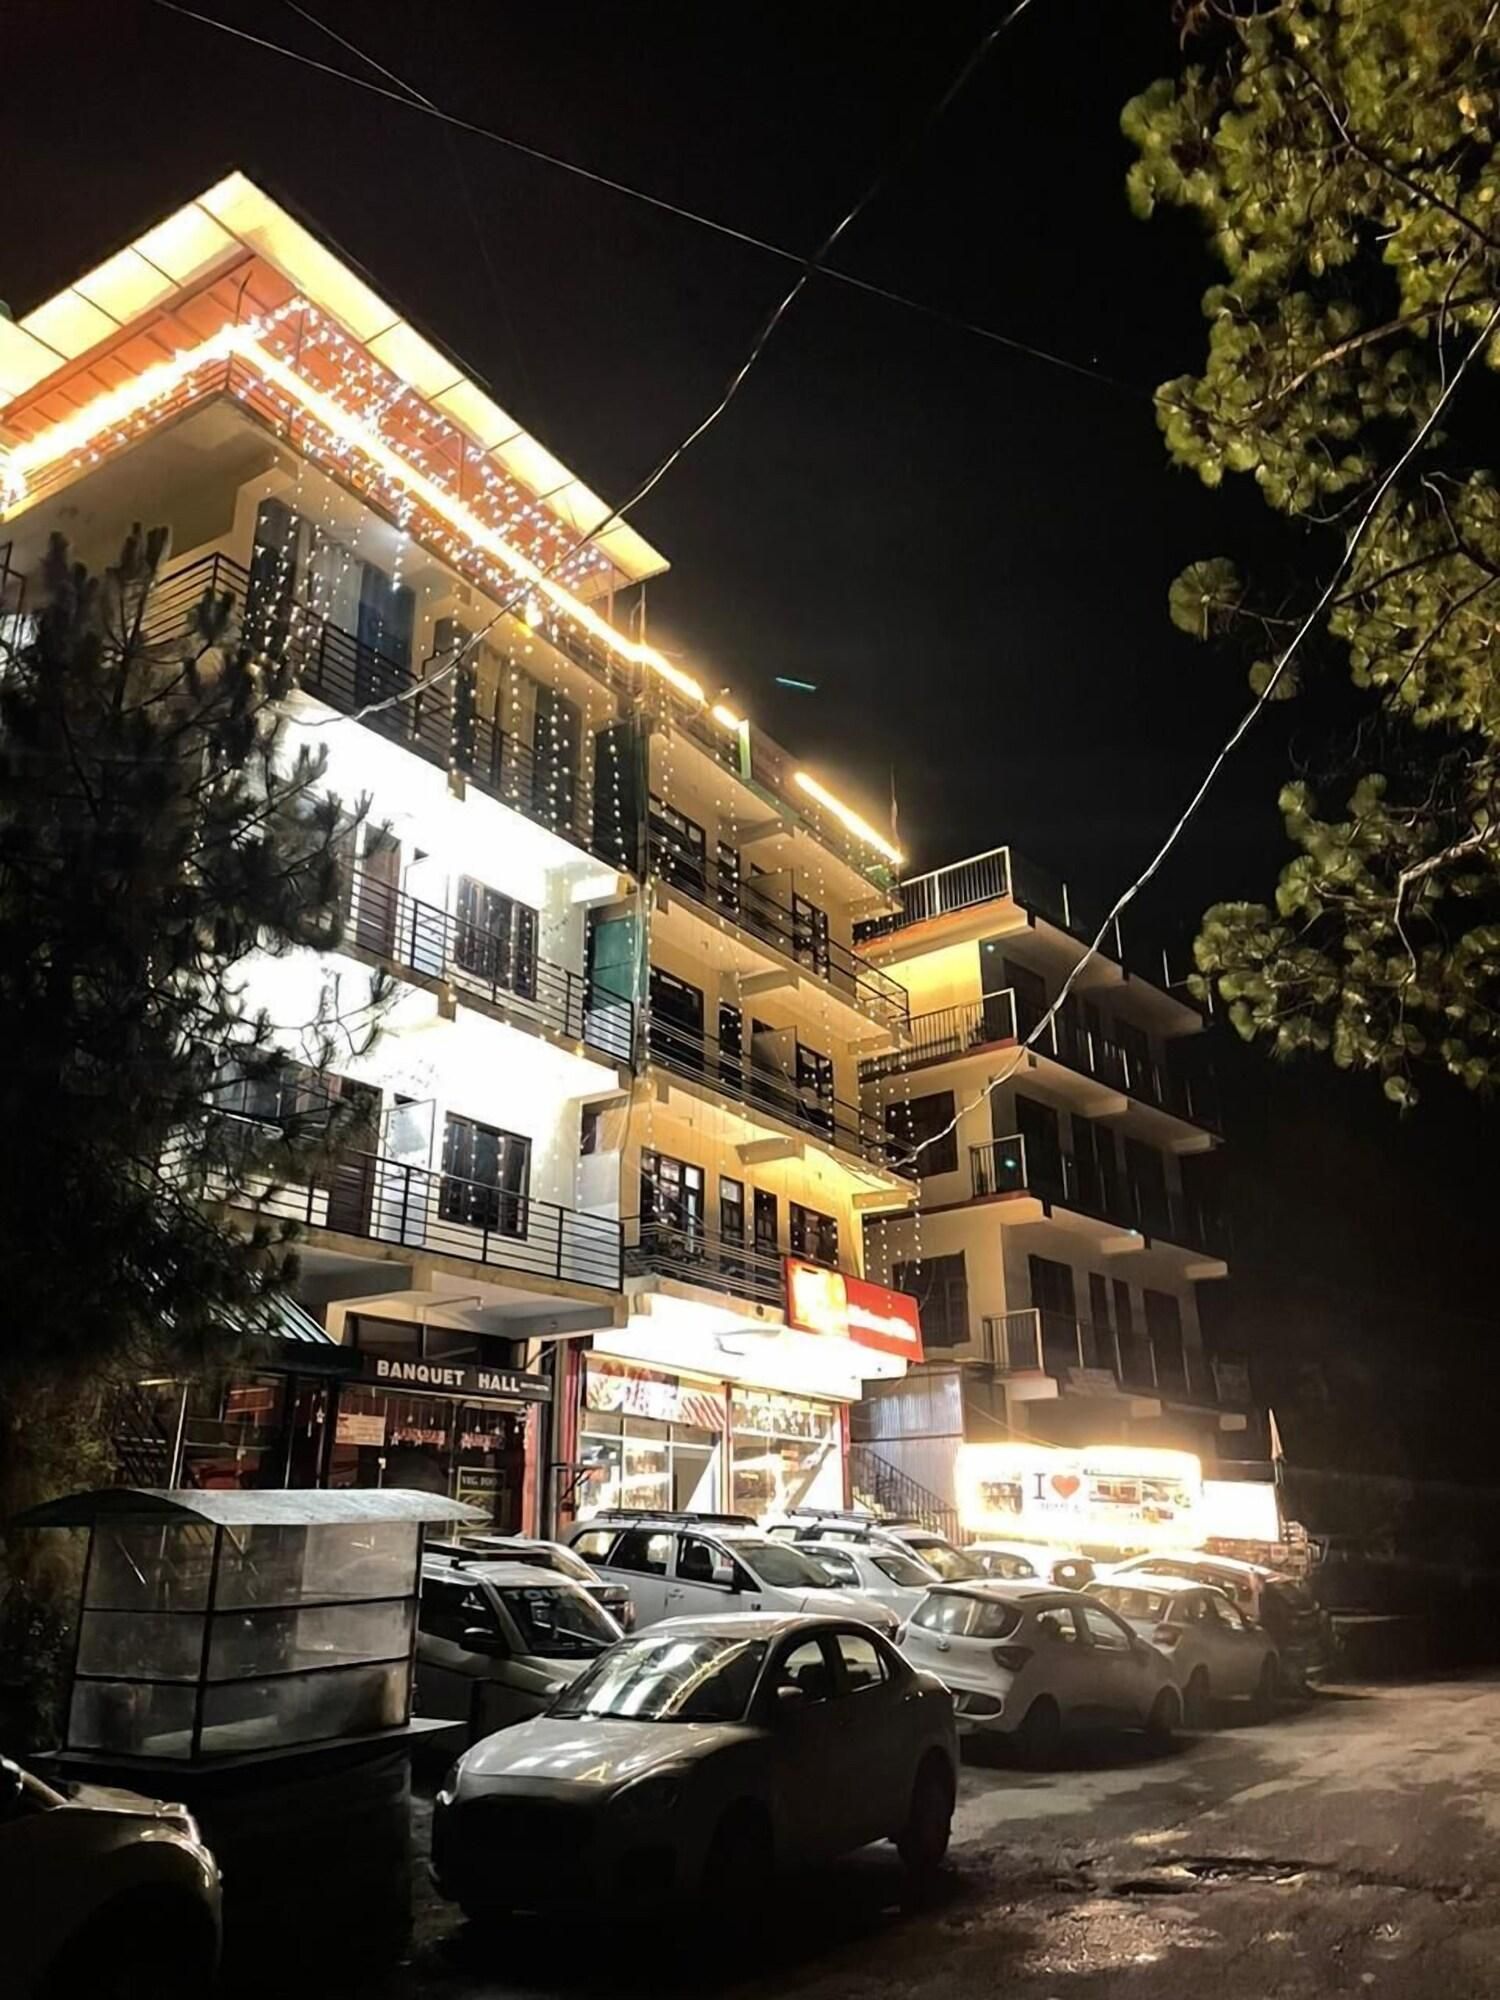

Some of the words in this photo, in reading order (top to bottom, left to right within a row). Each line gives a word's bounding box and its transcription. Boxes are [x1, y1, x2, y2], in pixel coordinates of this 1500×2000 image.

[376, 1359, 465, 1386] BANQUET
[478, 1372, 521, 1393] HALL
[1032, 1472, 1046, 1500] I
